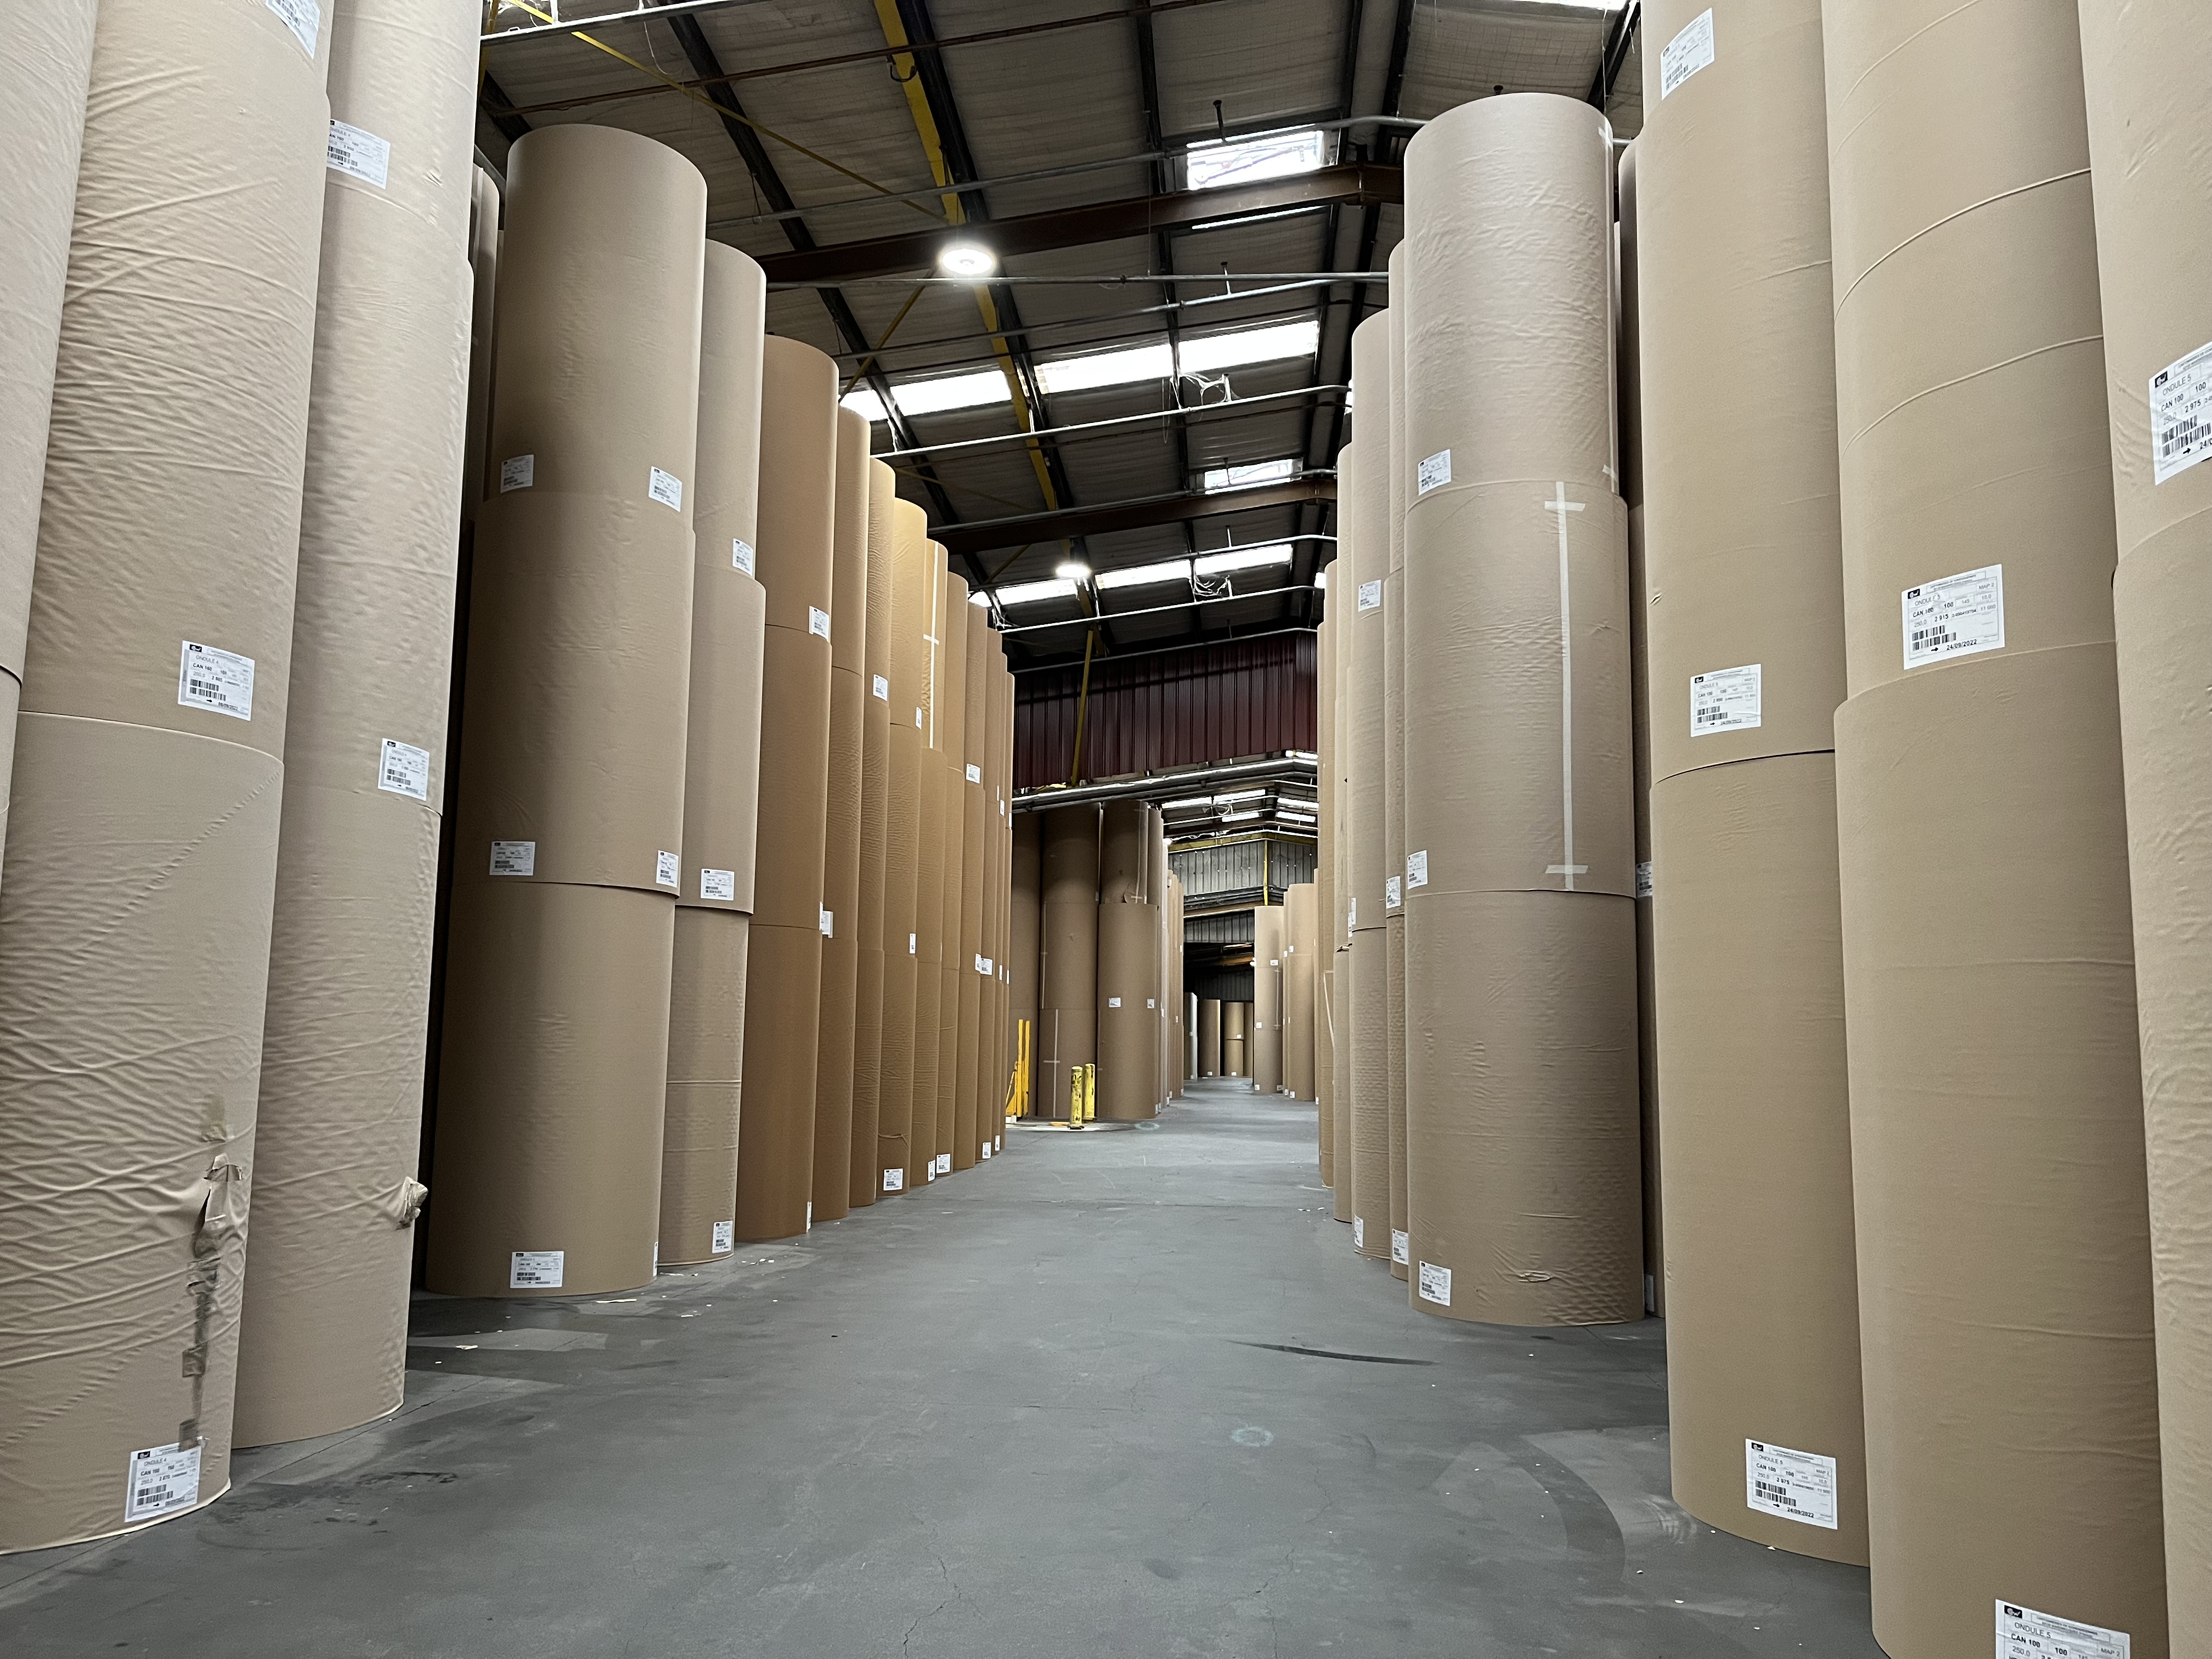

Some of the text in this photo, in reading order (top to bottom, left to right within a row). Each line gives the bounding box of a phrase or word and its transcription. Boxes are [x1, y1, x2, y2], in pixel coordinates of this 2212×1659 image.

[2163, 374, 2191, 396] ONDULE 5
[2196, 382, 2206, 393] 100
[2161, 393, 2184, 412] CAN 100
[2190, 399, 2201, 410] 975
[1915, 595, 1936, 606] ONDULE
[1912, 610, 1923, 618] CAN
[1946, 639, 1977, 651] 24/09/2022
[1758, 1454, 1779, 1464] ONDULE
[1787, 1506, 1814, 1518] 24/09/2022
[2014, 1622, 2044, 1637] ONDULE
[2011, 1633, 2041, 1648] CAN 100
[2012, 1645, 2030, 1657] 250.0
[2055, 1647, 2068, 1656] 100
